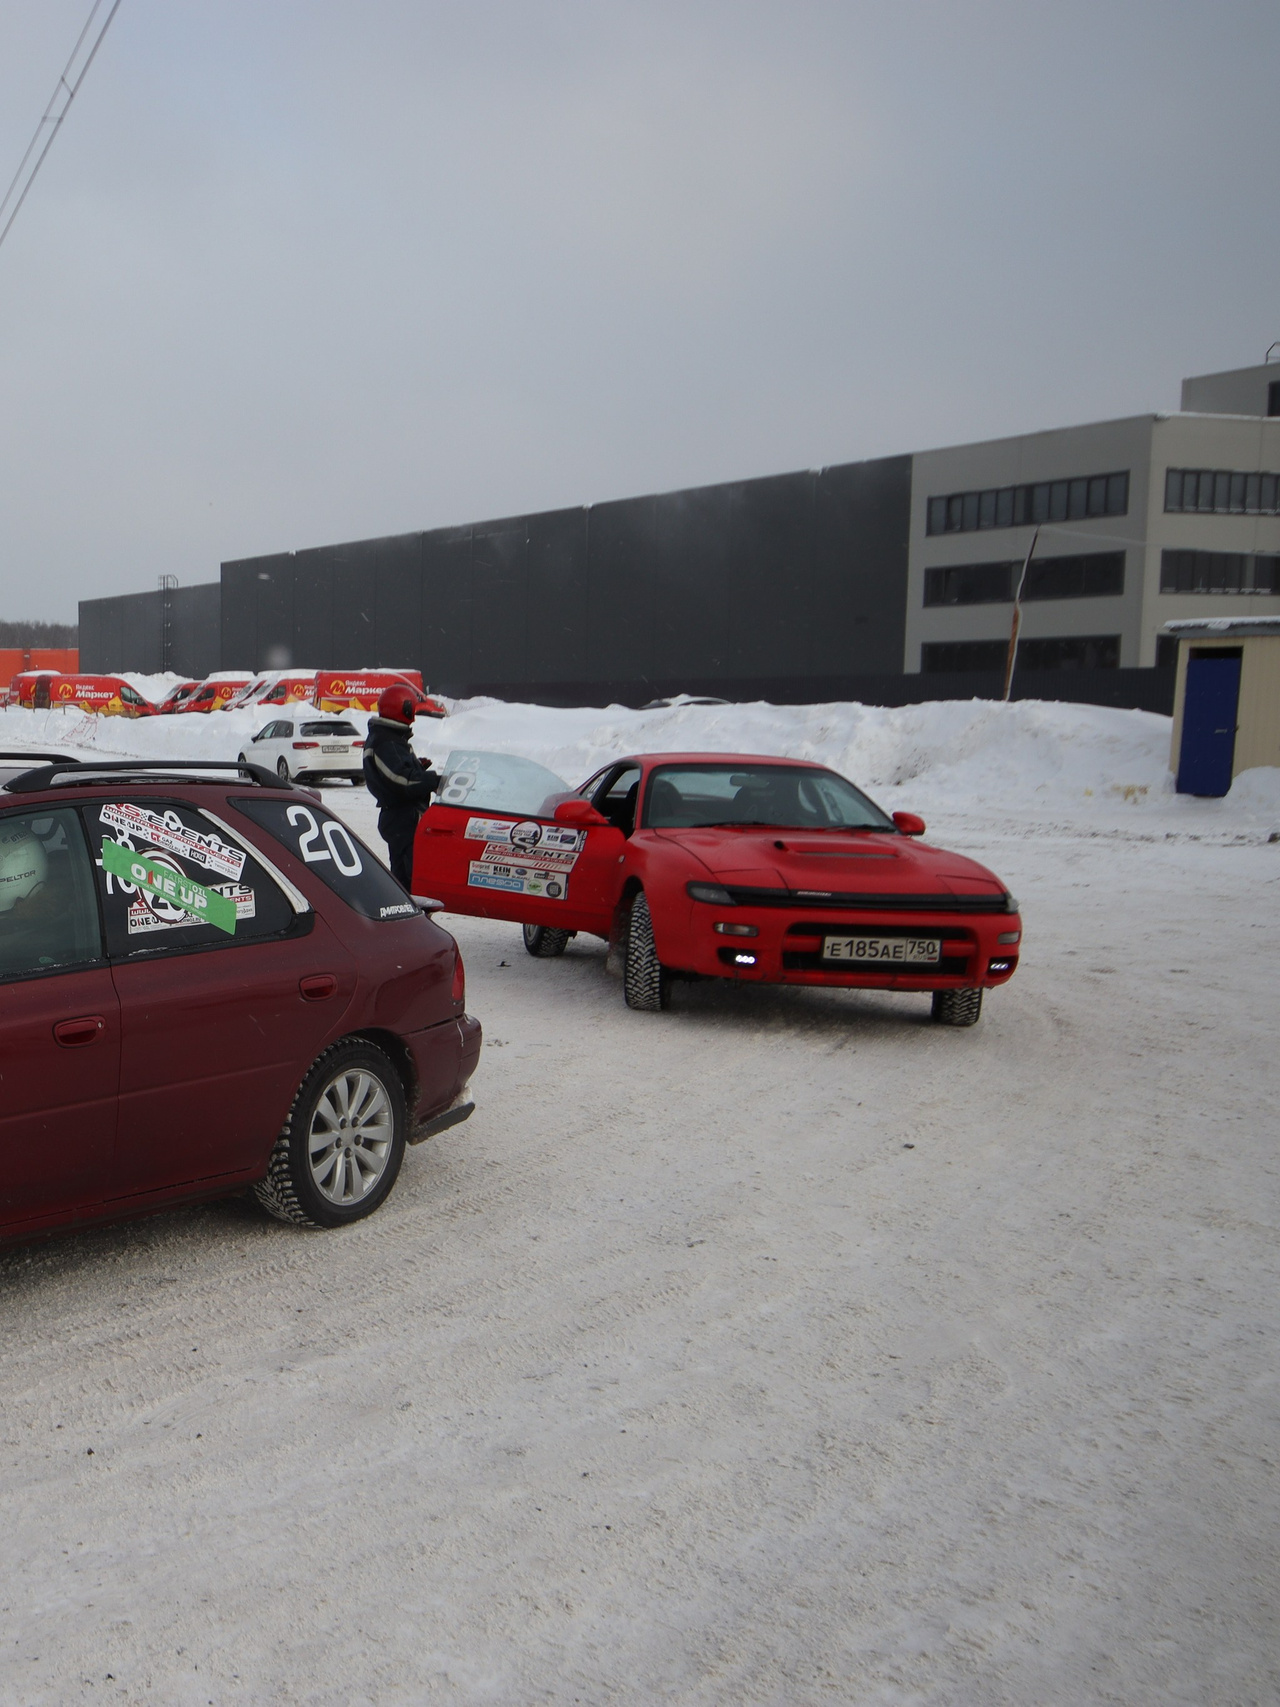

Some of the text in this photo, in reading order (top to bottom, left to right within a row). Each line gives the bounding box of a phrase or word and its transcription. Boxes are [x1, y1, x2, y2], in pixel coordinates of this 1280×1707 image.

[75, 690, 115, 699] Маркет
[103, 811, 143, 833] ONE UP
[286, 805, 363, 877] 20
[130, 863, 176, 897] ONE
[179, 886, 208, 909] UP
[130, 917, 152, 927] ONE
[908, 941, 936, 955] 750
